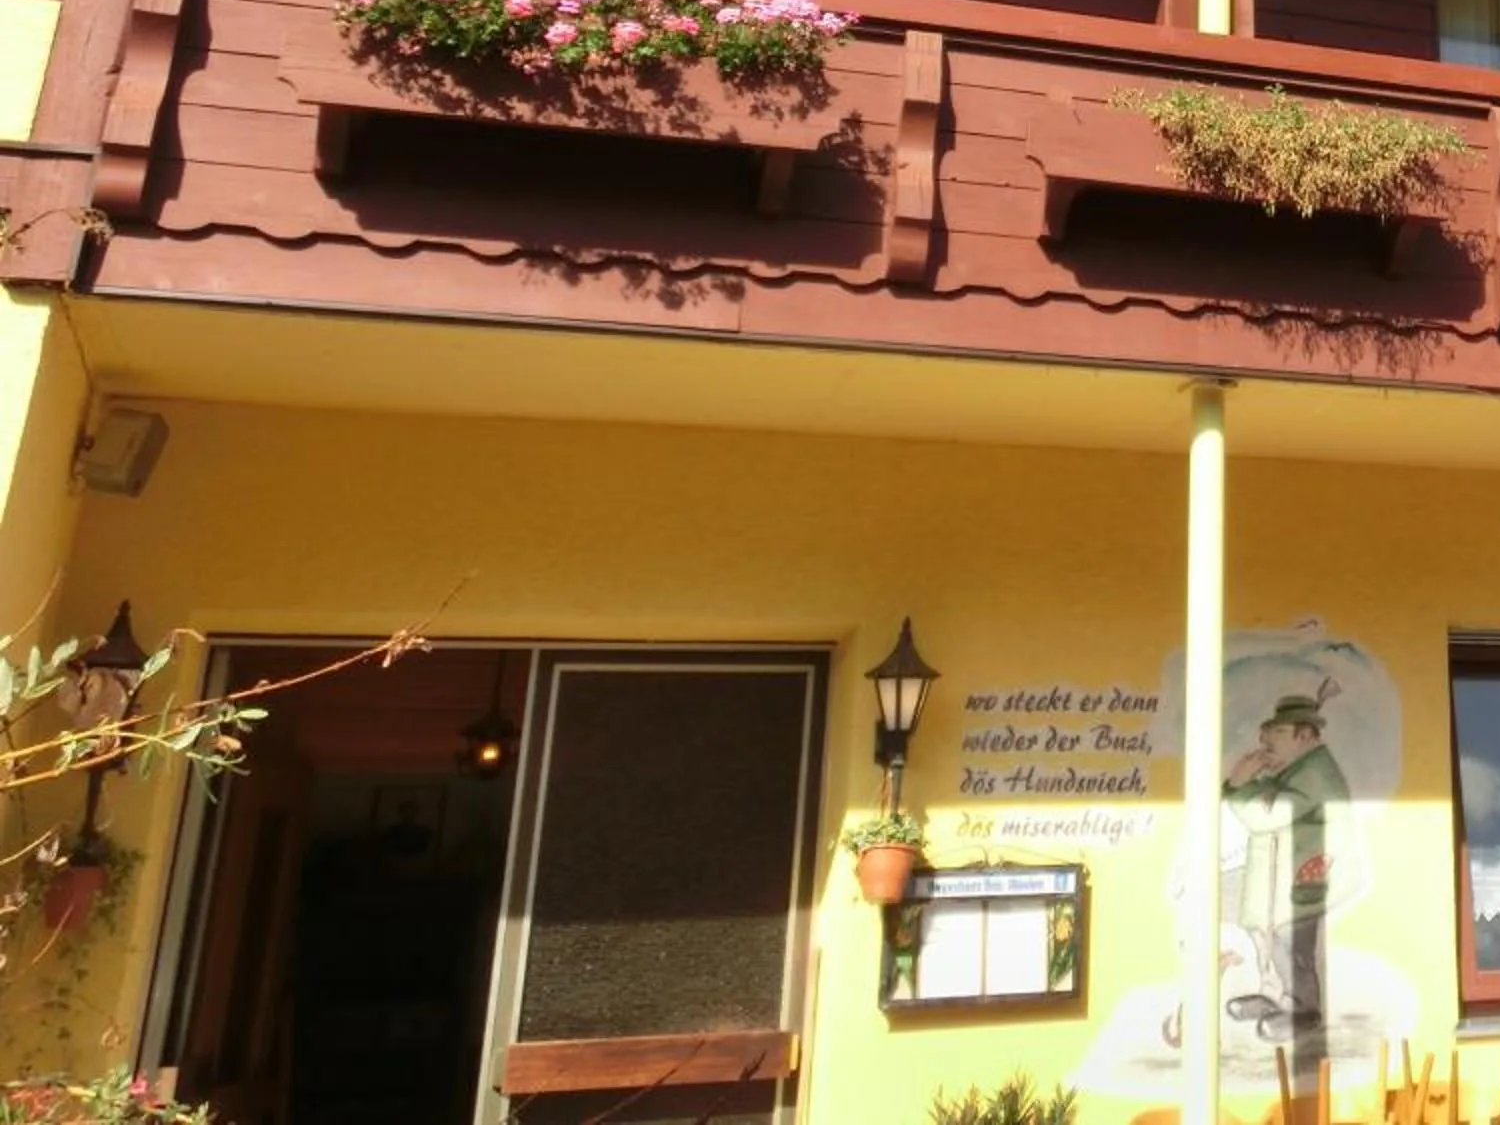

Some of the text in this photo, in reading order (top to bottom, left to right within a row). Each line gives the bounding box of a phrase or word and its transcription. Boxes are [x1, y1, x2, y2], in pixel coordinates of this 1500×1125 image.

[965, 686, 1160, 713] wo steckt er denn
[961, 724, 1039, 753] wieder
[1045, 725, 1081, 753] der
[960, 767, 997, 796] dös
[956, 810, 994, 839] dös
